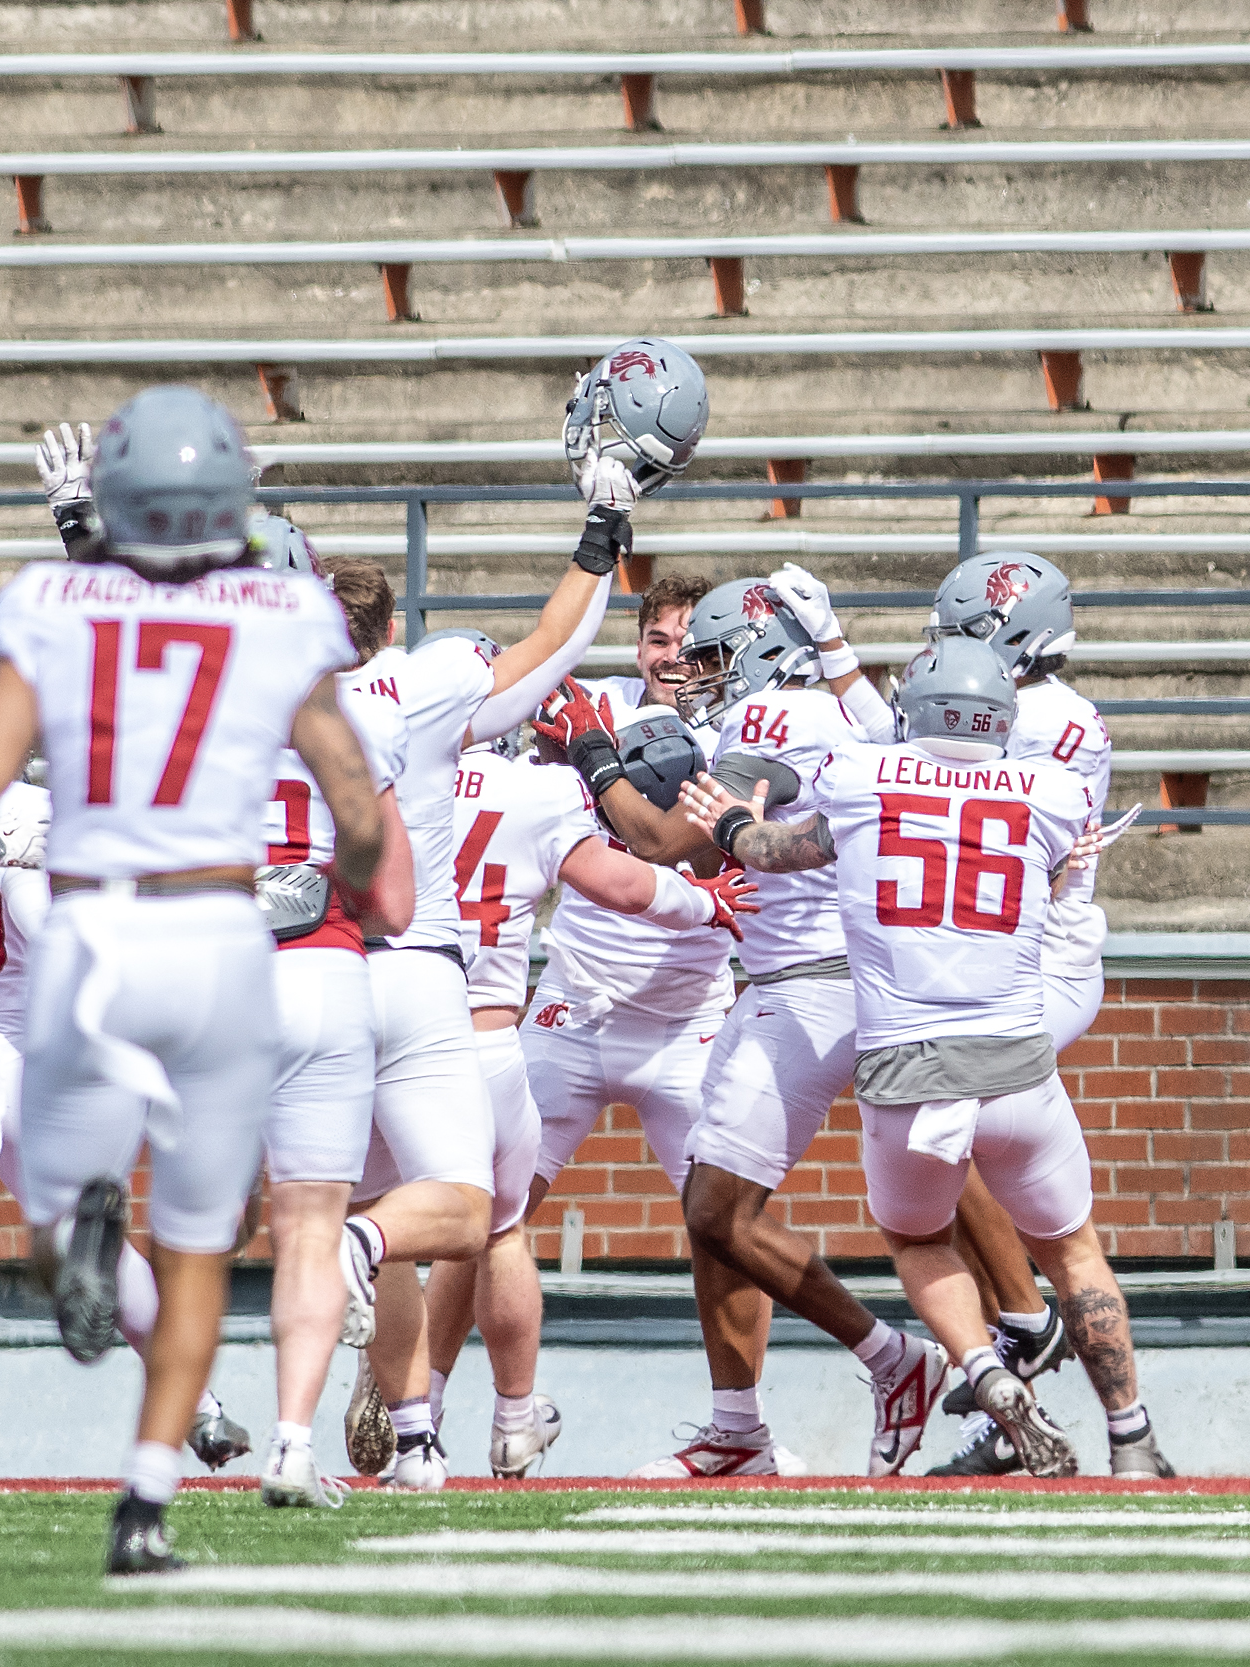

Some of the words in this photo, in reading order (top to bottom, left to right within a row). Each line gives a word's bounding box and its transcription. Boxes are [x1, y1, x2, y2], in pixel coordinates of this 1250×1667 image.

[84, 620, 234, 806] 17
[741, 704, 790, 750] 84
[971, 713, 992, 733] 56
[872, 792, 1032, 936] 56
